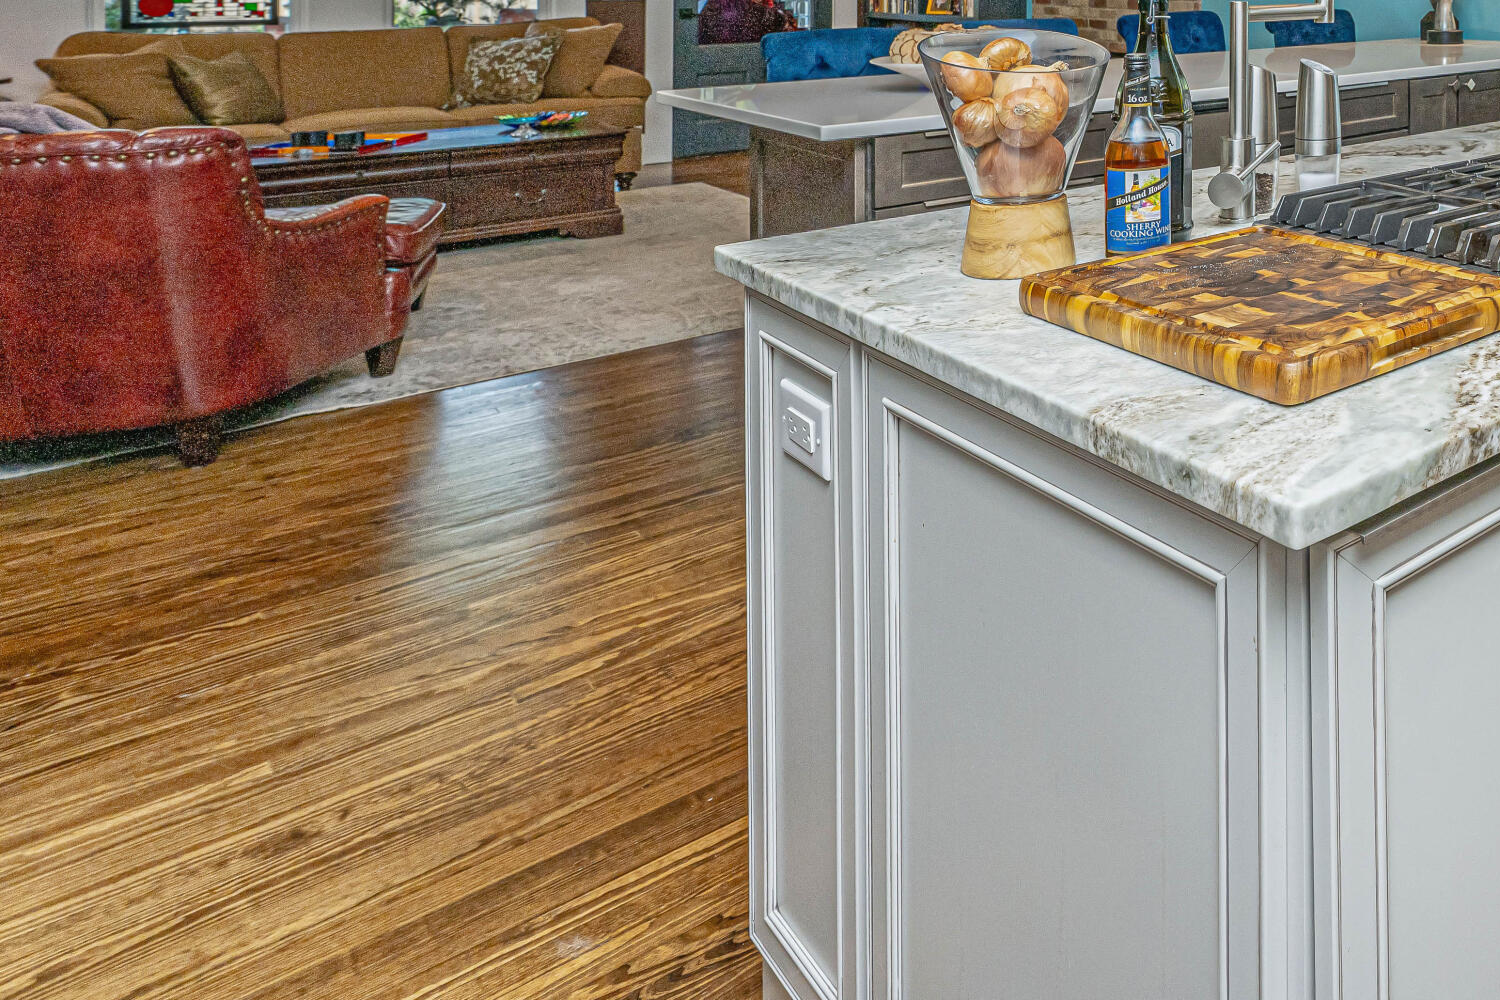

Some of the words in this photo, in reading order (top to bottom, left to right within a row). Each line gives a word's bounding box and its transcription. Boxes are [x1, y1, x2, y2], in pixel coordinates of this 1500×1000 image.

[1115, 189, 1147, 206] Holland
[1126, 220, 1161, 231] SHERRY
[1109, 229, 1154, 238] COOKING
